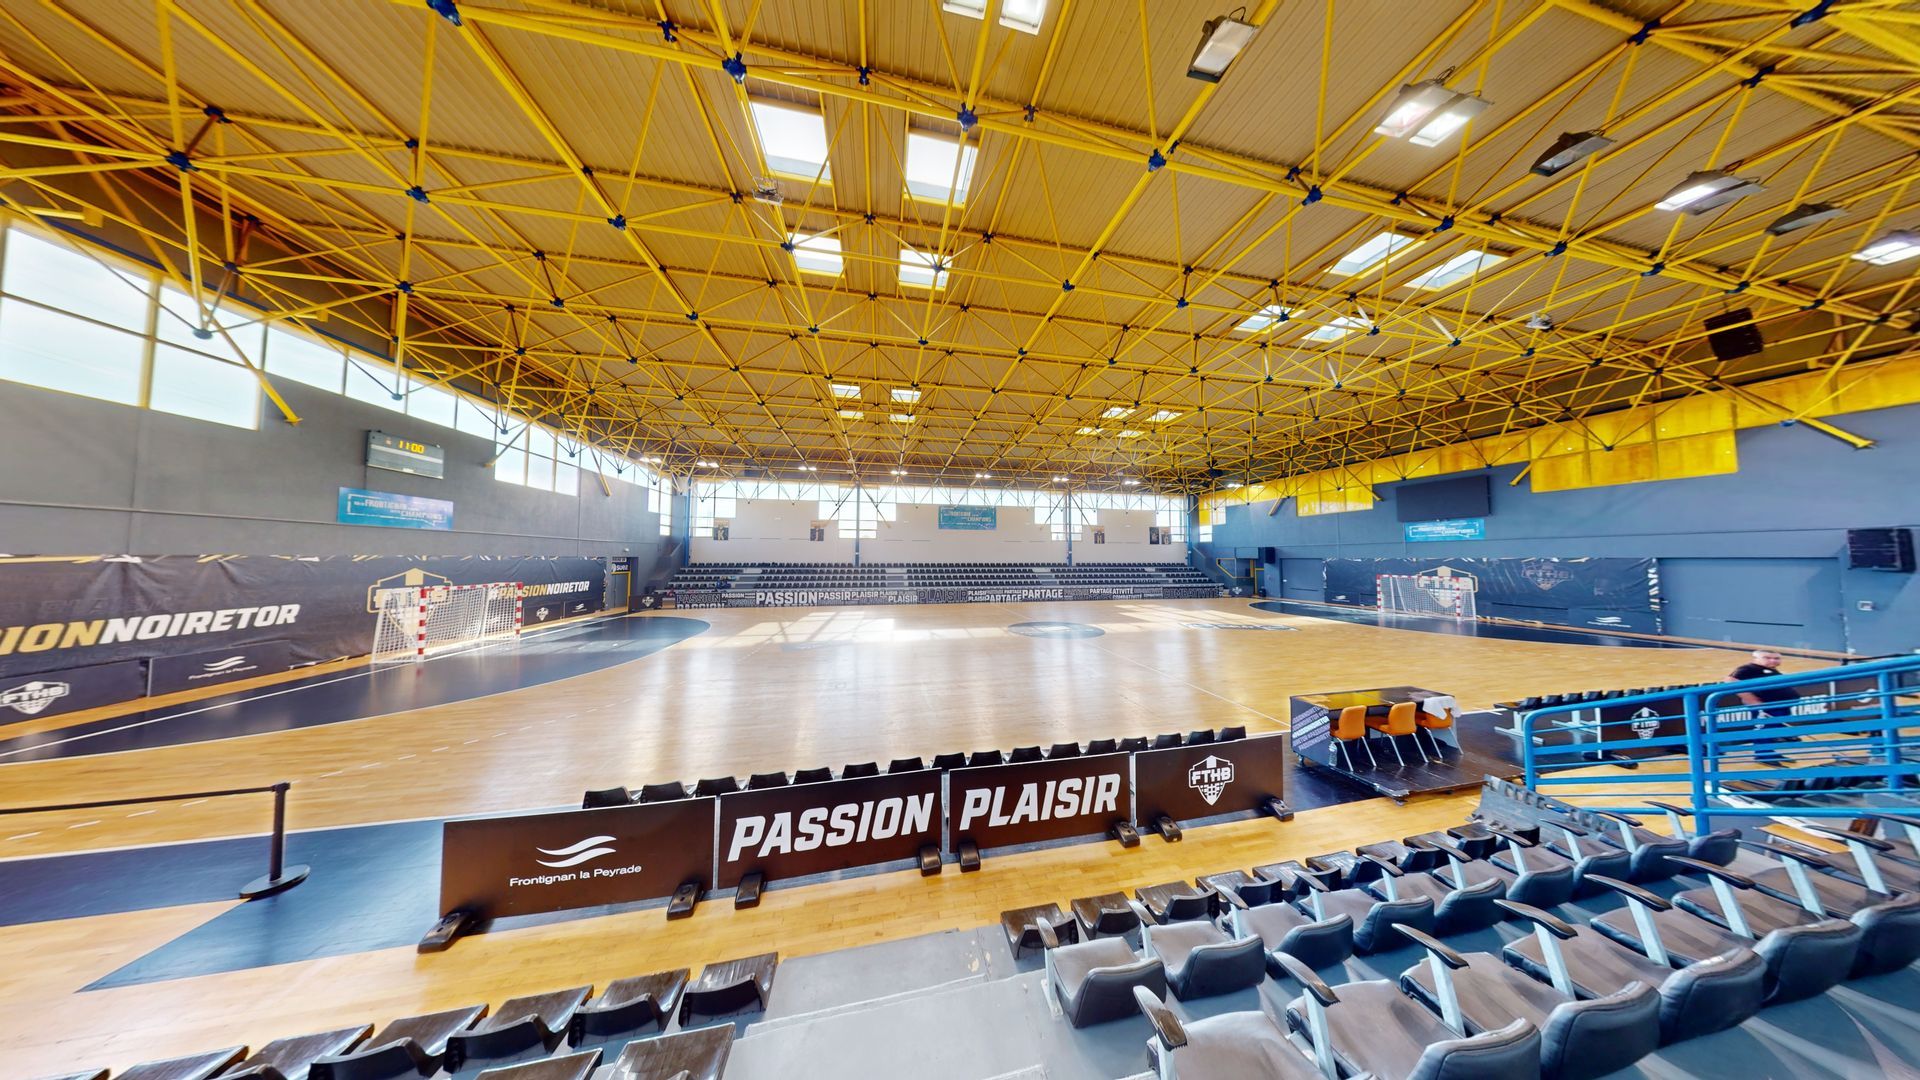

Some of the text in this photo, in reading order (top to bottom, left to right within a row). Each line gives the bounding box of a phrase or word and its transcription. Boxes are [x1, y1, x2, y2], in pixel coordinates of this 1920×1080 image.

[755, 591, 818, 605] PASSION
[888, 595, 918, 603] PLAISIR
[1022, 589, 1063, 599] PARTAGE
[0, 603, 301, 655] IONNOIRETOR
[1191, 768, 1232, 785] FTHB
[959, 774, 1121, 831] PLAISIR
[727, 792, 935, 862] PASSION
[509, 864, 642, 887] Frontignan la Peyrade
